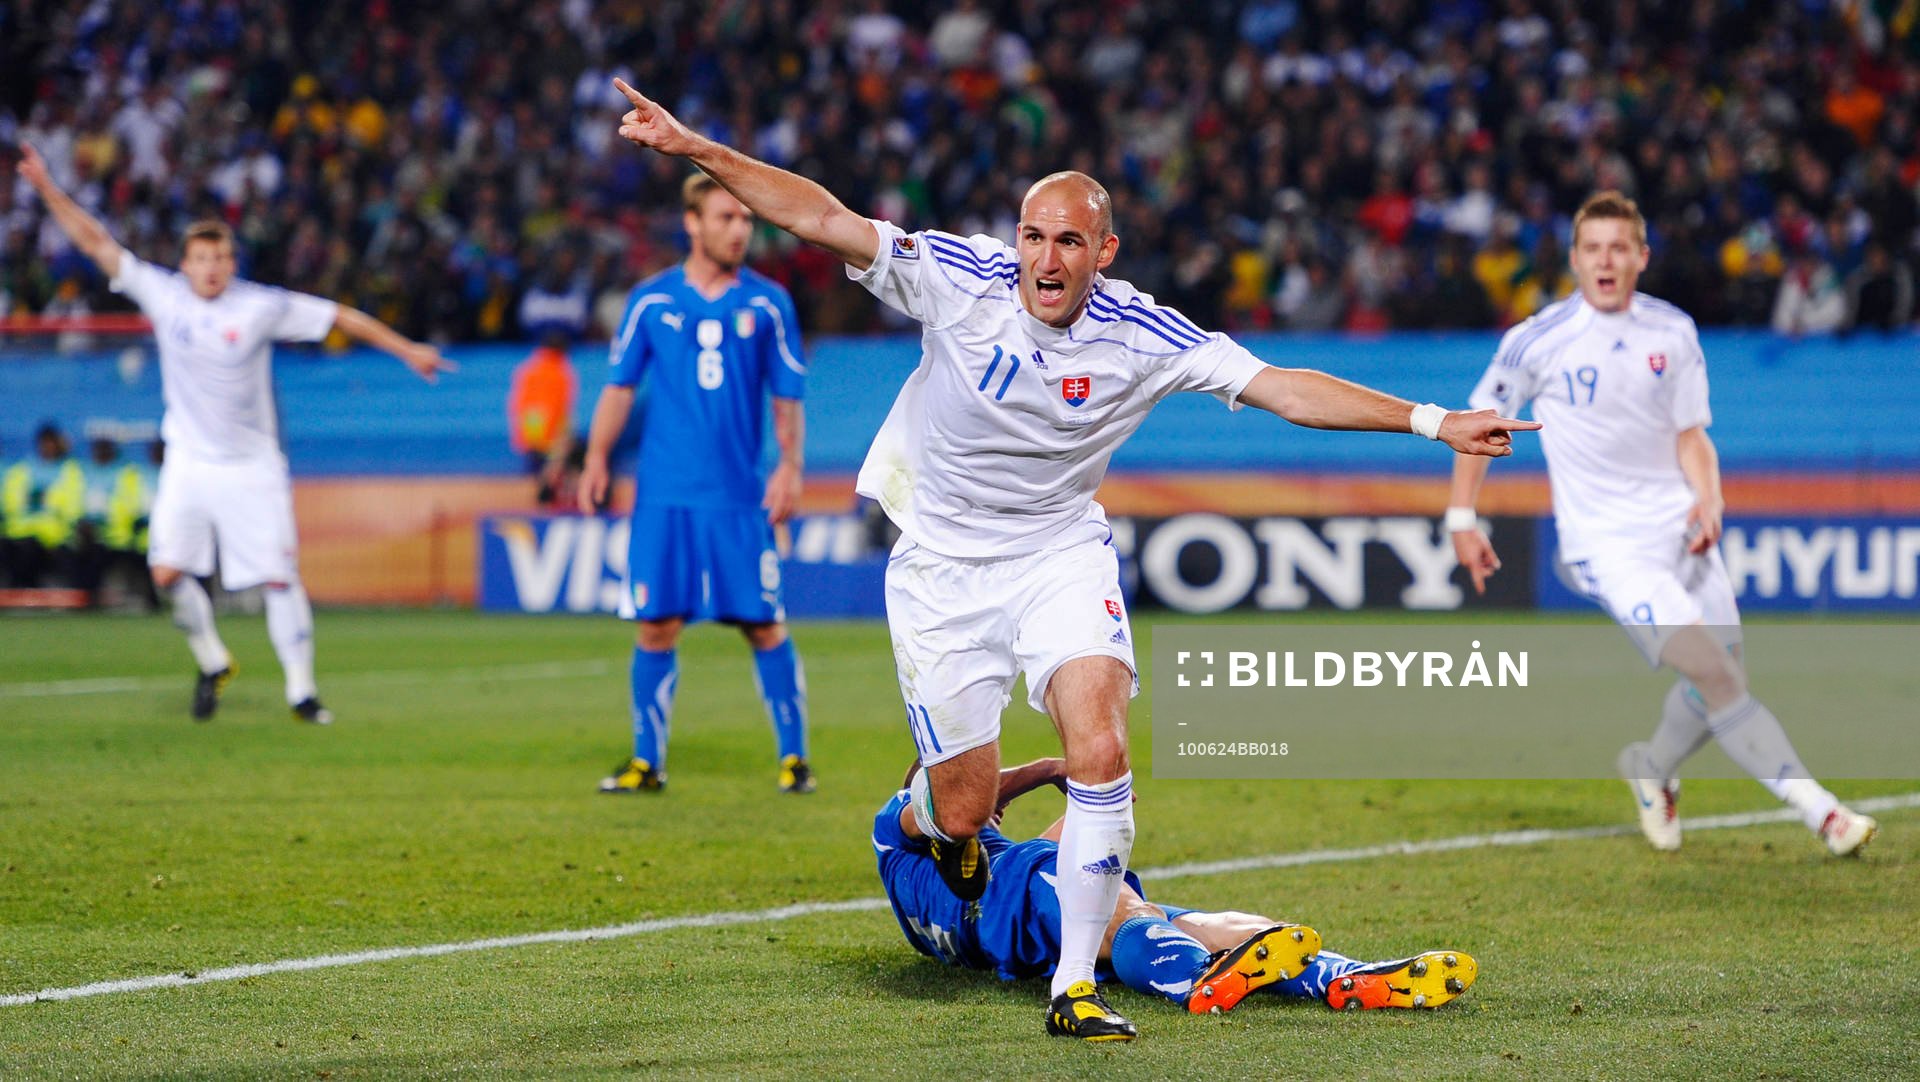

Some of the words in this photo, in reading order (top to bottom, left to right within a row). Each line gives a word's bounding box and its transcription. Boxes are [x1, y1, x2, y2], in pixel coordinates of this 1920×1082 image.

[697, 349, 724, 390] 6
[978, 344, 1020, 400] 11
[1563, 366, 1598, 405] 19
[760, 549, 781, 590] 6
